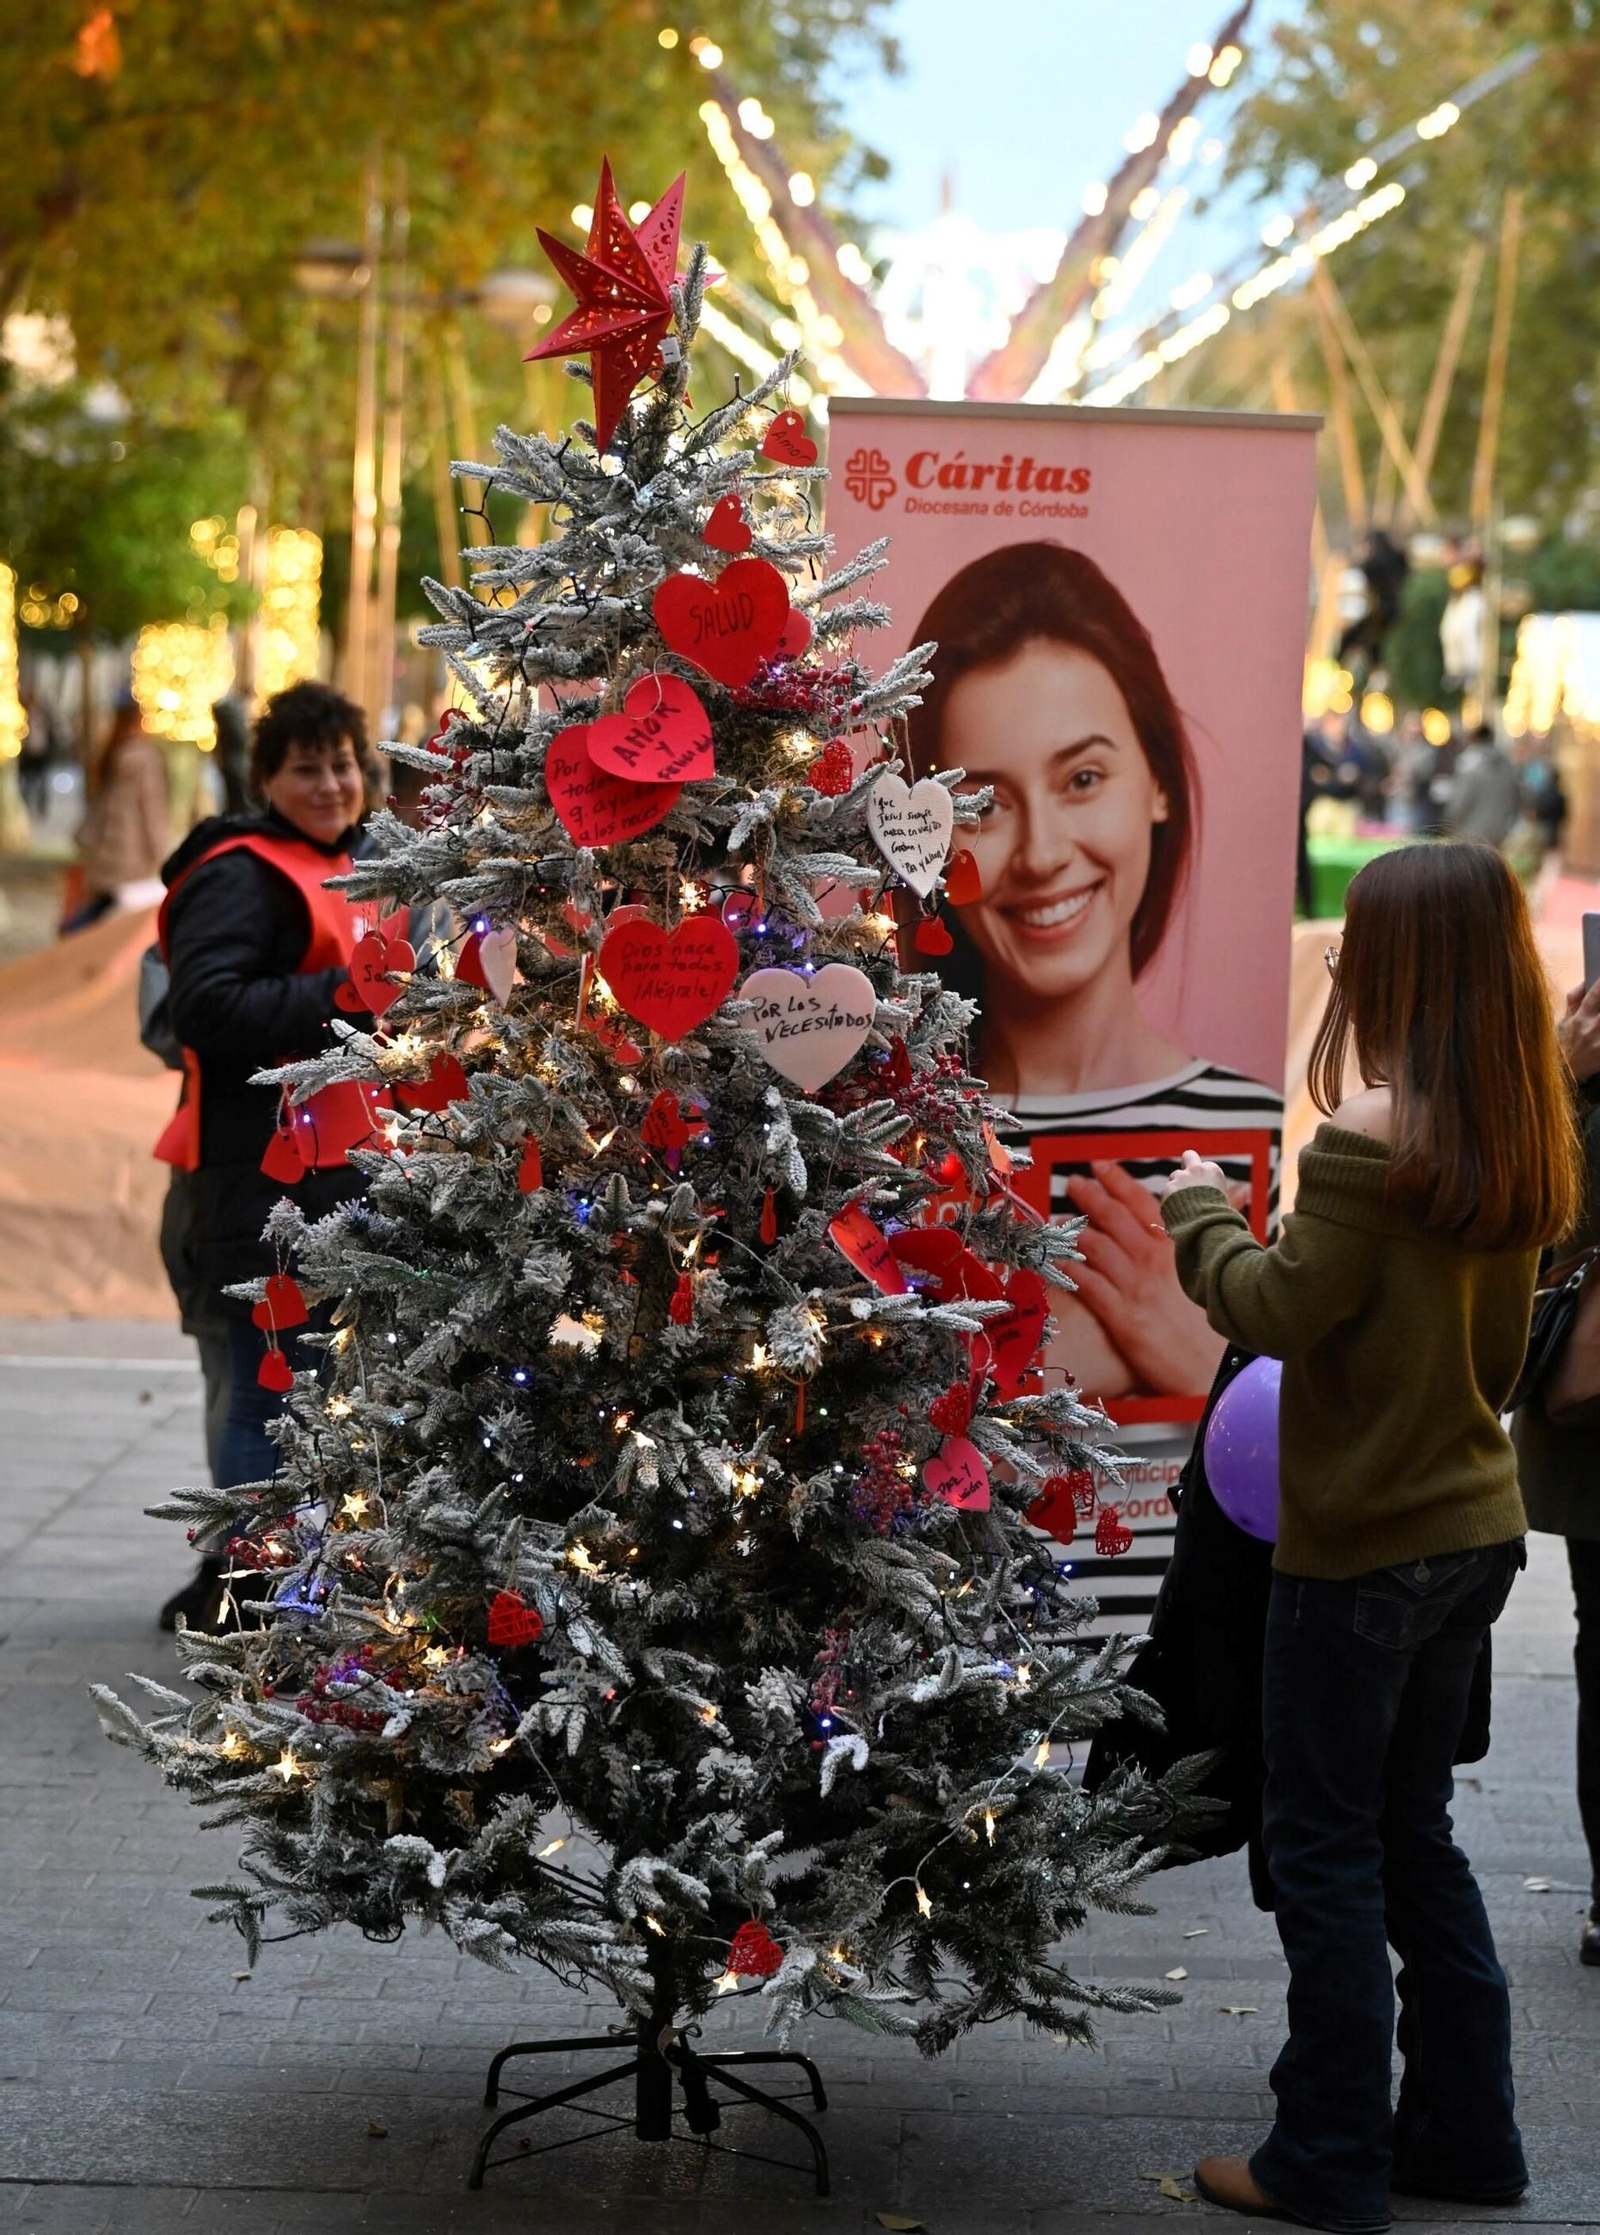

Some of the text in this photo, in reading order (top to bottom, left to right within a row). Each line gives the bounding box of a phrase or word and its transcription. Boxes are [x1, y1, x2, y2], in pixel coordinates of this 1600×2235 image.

[904, 450, 1092, 494] Cáritas
[904, 497, 1089, 519] Diocesana de Córdoba
[689, 591, 754, 645] SALUD
[612, 701, 681, 768] AMOR
[553, 759, 583, 781] Por
[621, 941, 716, 960] Dios nace
[620, 961, 661, 981] para
